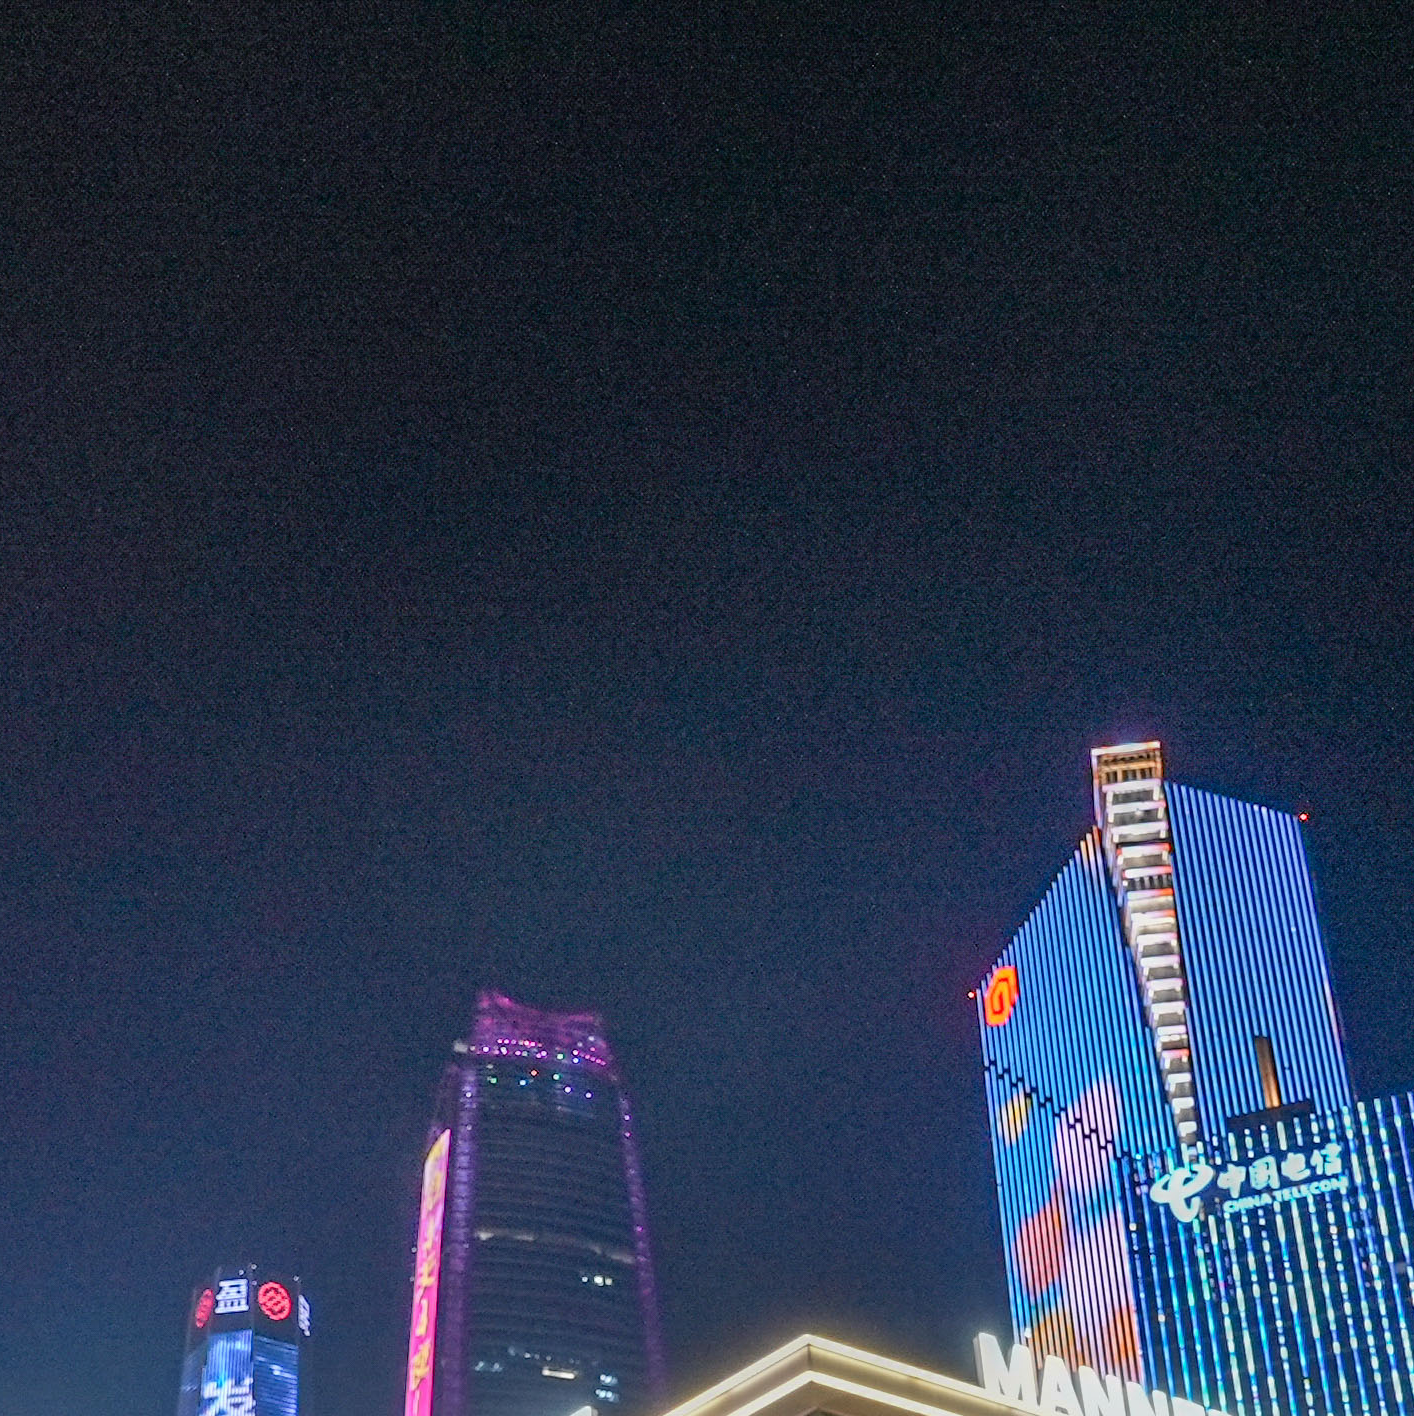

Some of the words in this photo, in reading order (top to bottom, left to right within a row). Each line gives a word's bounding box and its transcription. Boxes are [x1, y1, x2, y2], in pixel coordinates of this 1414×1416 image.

[1216, 1142, 1343, 1199] 中国电信
[1223, 1193, 1273, 1214] CHINA
[1272, 1174, 1350, 1203] TELECOM
